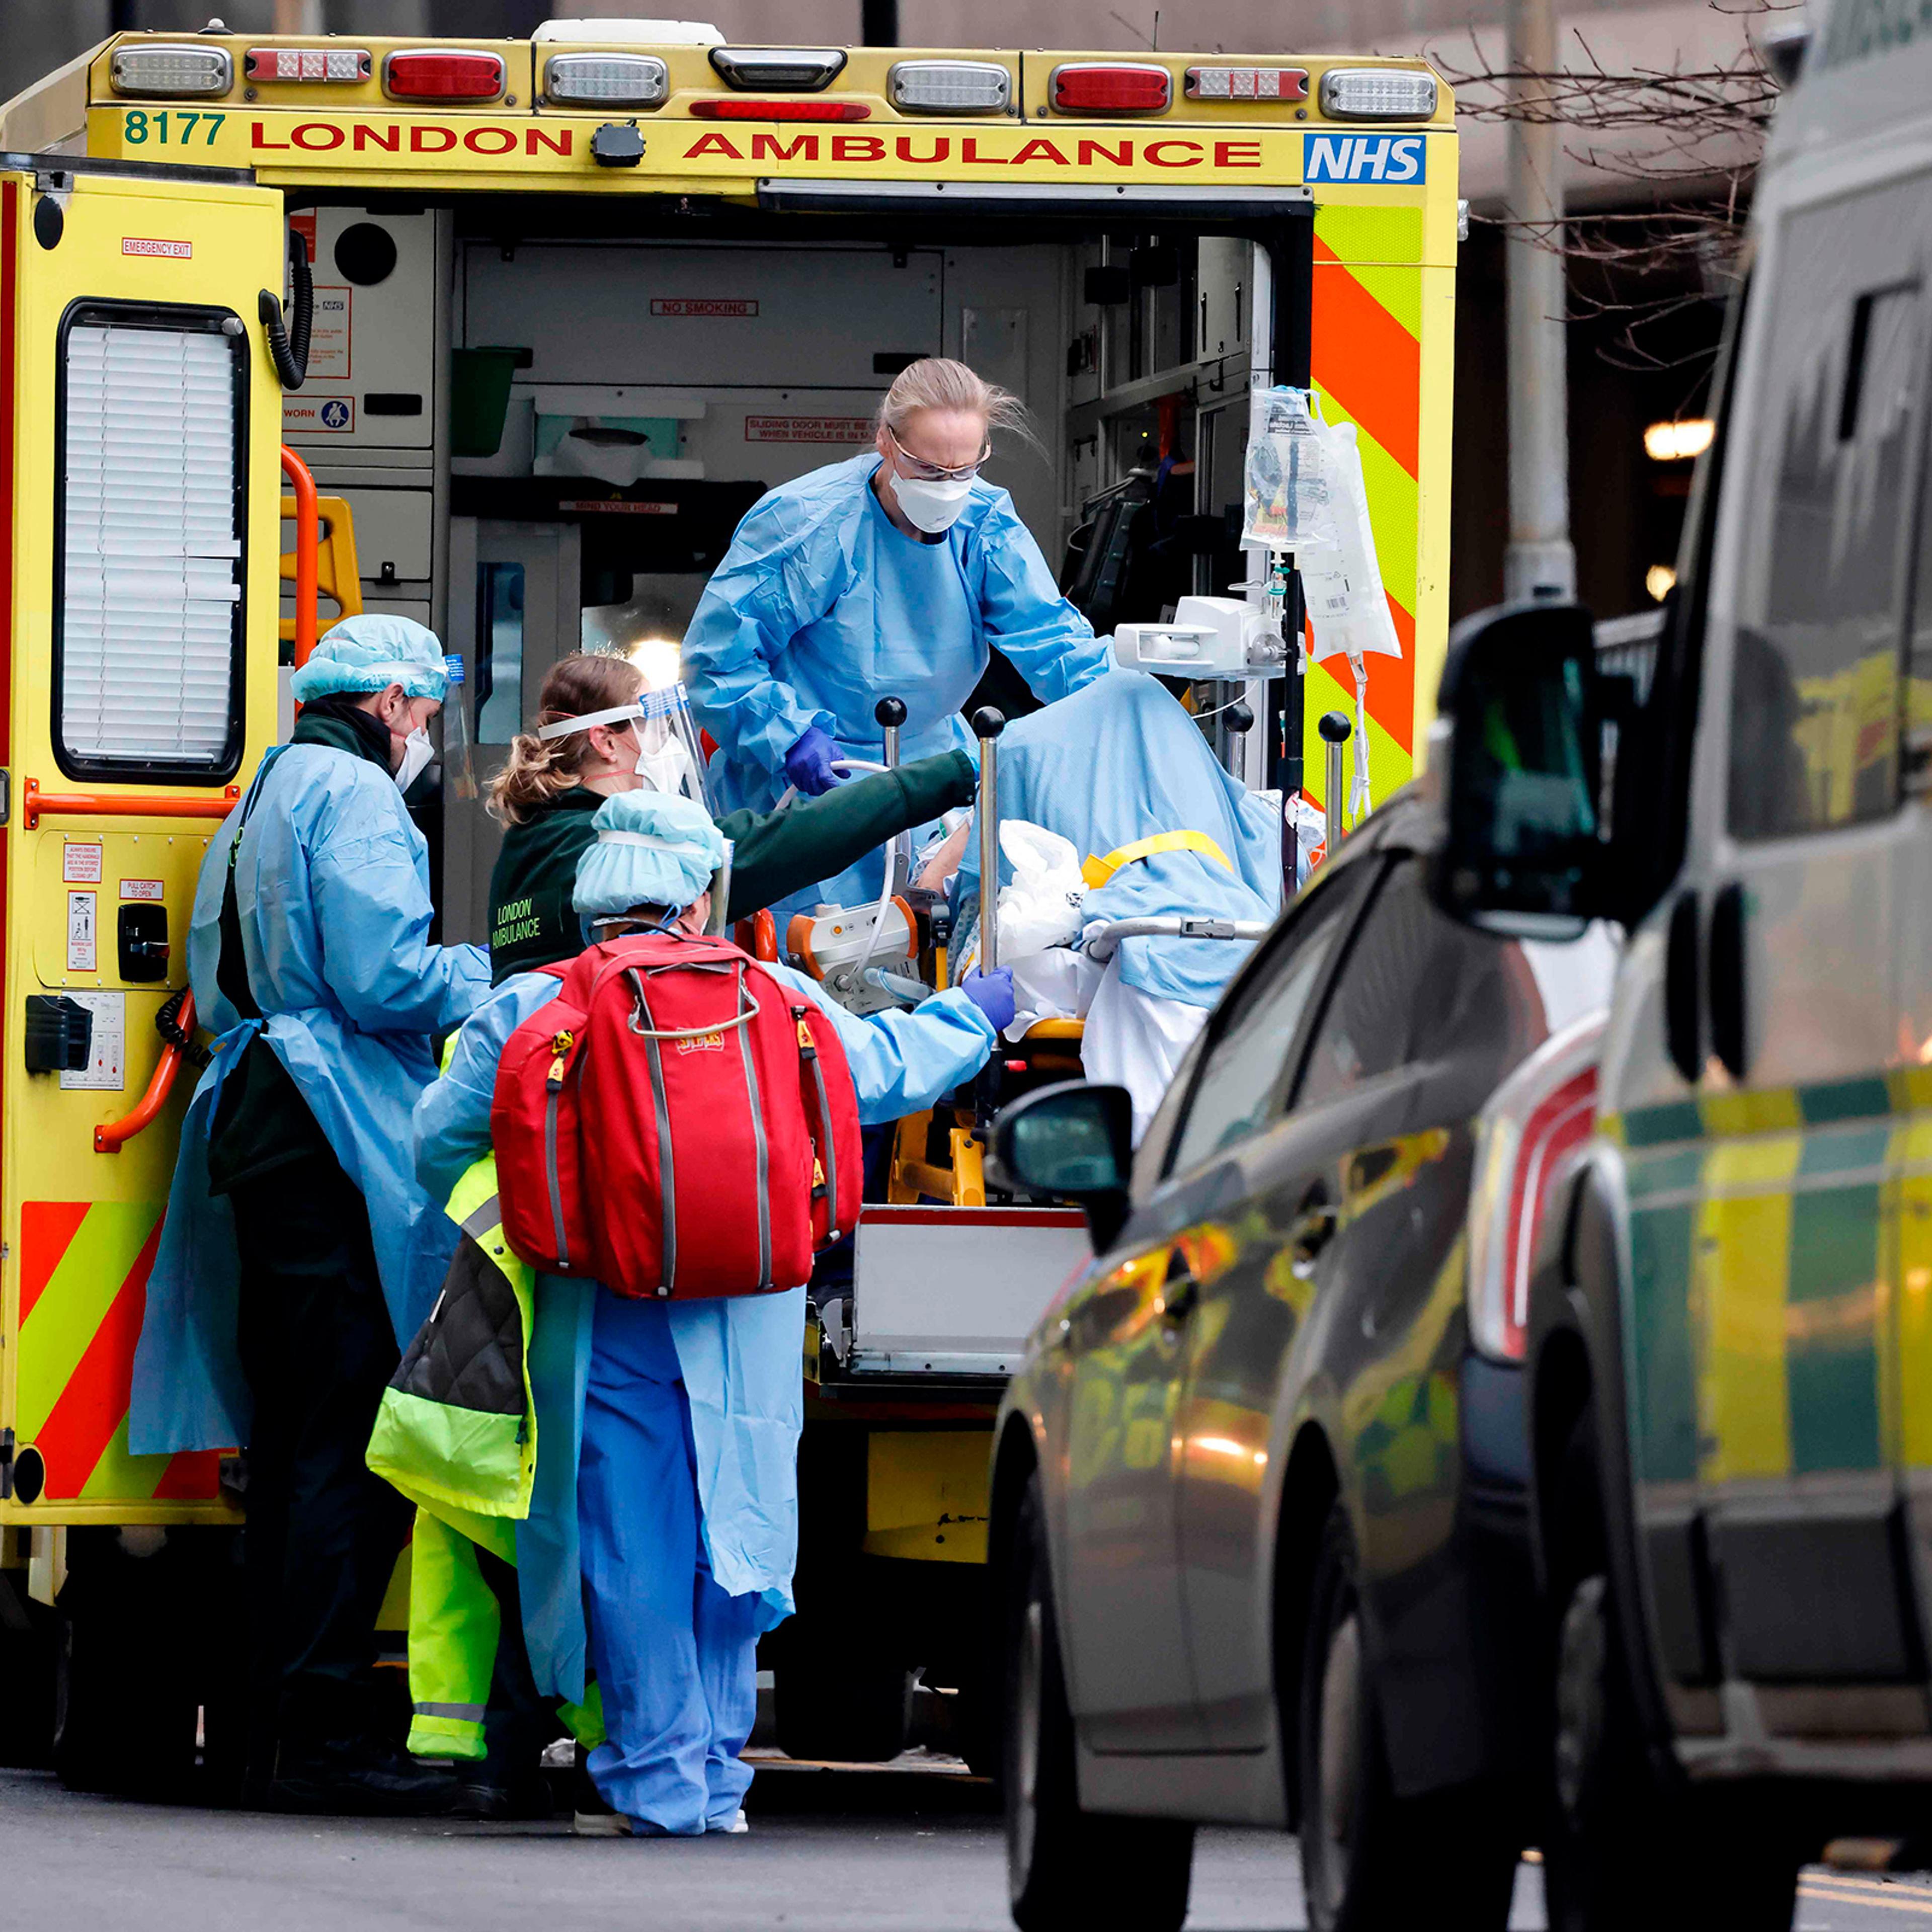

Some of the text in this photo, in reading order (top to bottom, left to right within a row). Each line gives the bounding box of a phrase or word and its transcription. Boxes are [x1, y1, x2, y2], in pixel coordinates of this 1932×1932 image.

[124, 111, 225, 145] 8177
[252, 122, 1260, 168] LONDON AMBULANCE
[1306, 137, 1422, 181] NHS
[124, 240, 189, 256] EMERGENCY EXIT
[323, 302, 343, 310] NHS
[663, 302, 747, 313] NO SMOKING
[750, 420, 789, 428] SLIDING
[791, 421, 821, 429] DOOR
[824, 421, 850, 429] MUST
[760, 430, 788, 438] WHEN
[792, 431, 833, 439] VEHICLE
[836, 431, 845, 440] IS
[848, 432, 858, 440] IN
[634, 503, 661, 513] HEAD
[497, 898, 532, 925] LONDON
